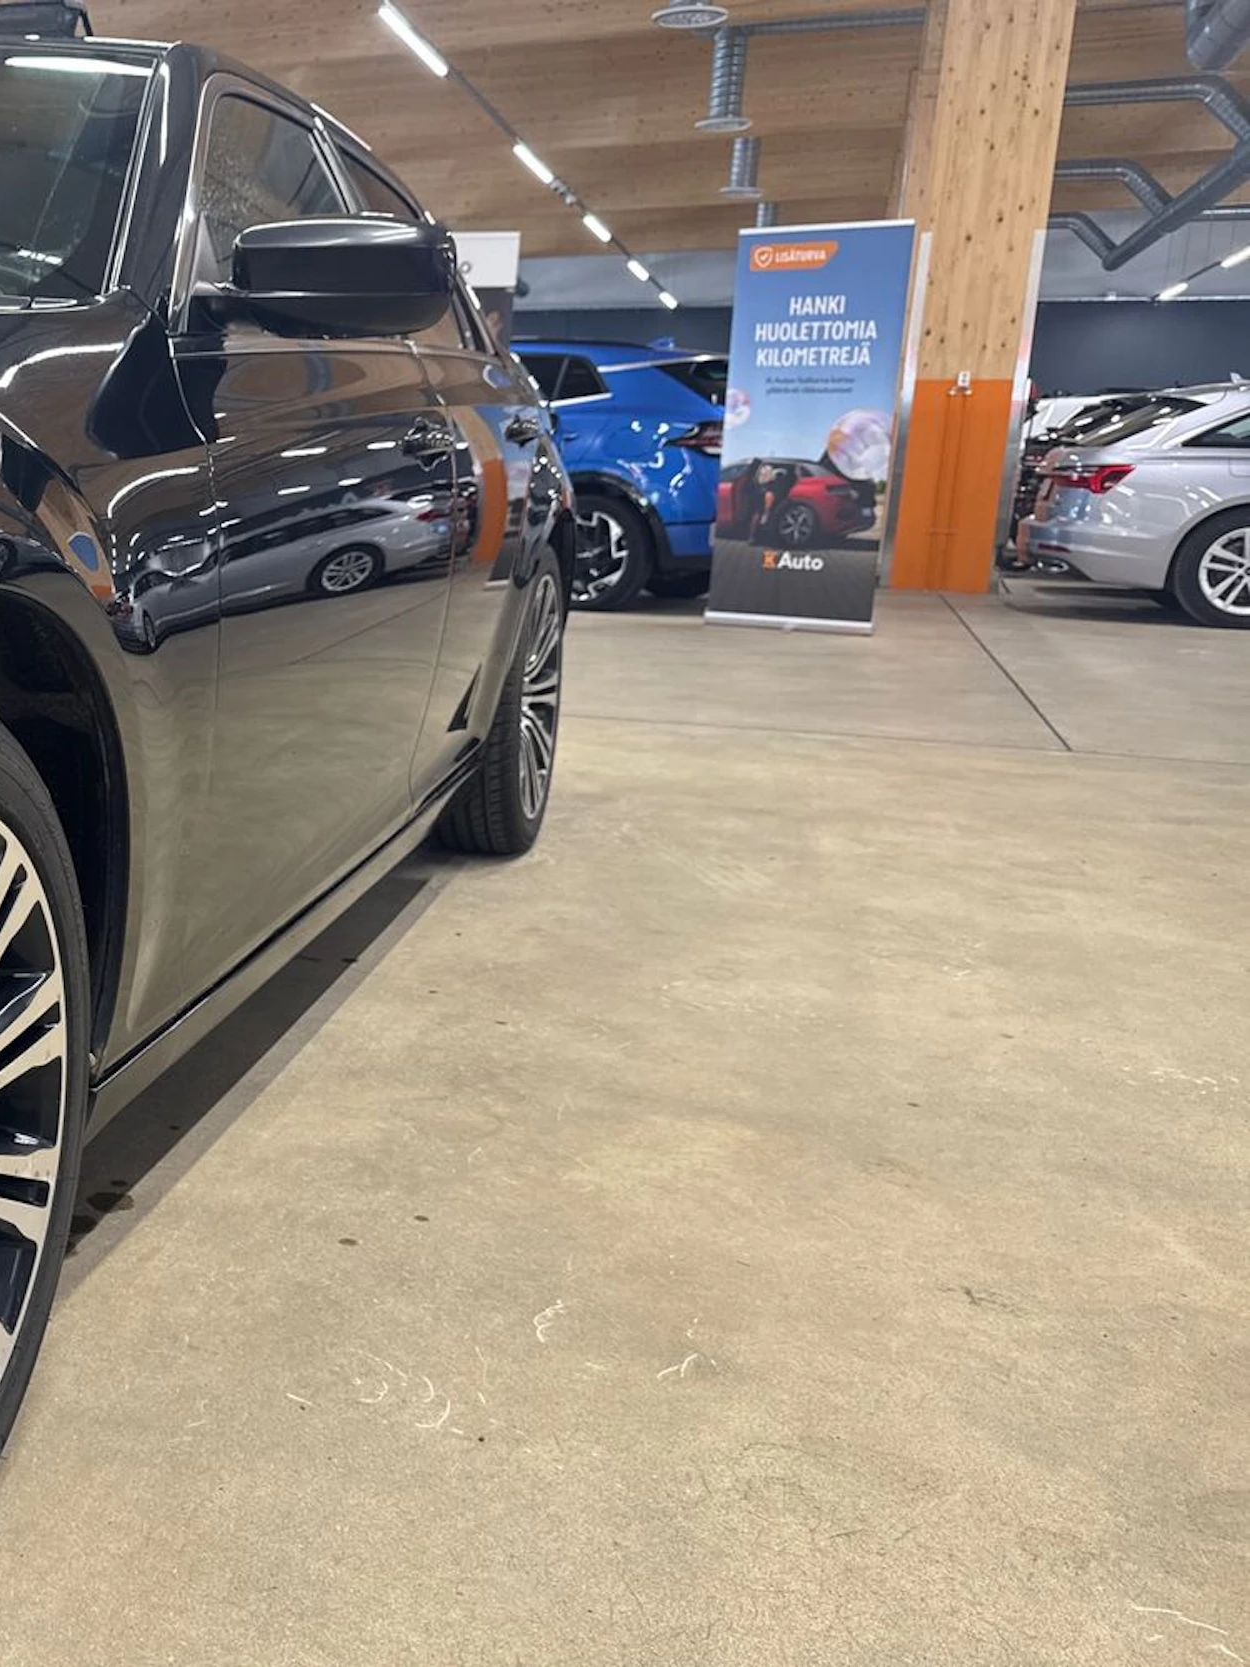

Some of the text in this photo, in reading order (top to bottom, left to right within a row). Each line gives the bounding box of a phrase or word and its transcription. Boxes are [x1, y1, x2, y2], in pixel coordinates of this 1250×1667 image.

[789, 295, 846, 316] HANKI
[754, 320, 877, 342] HUOLETTOMIA
[756, 340, 870, 367] KILOMETREJÄ
